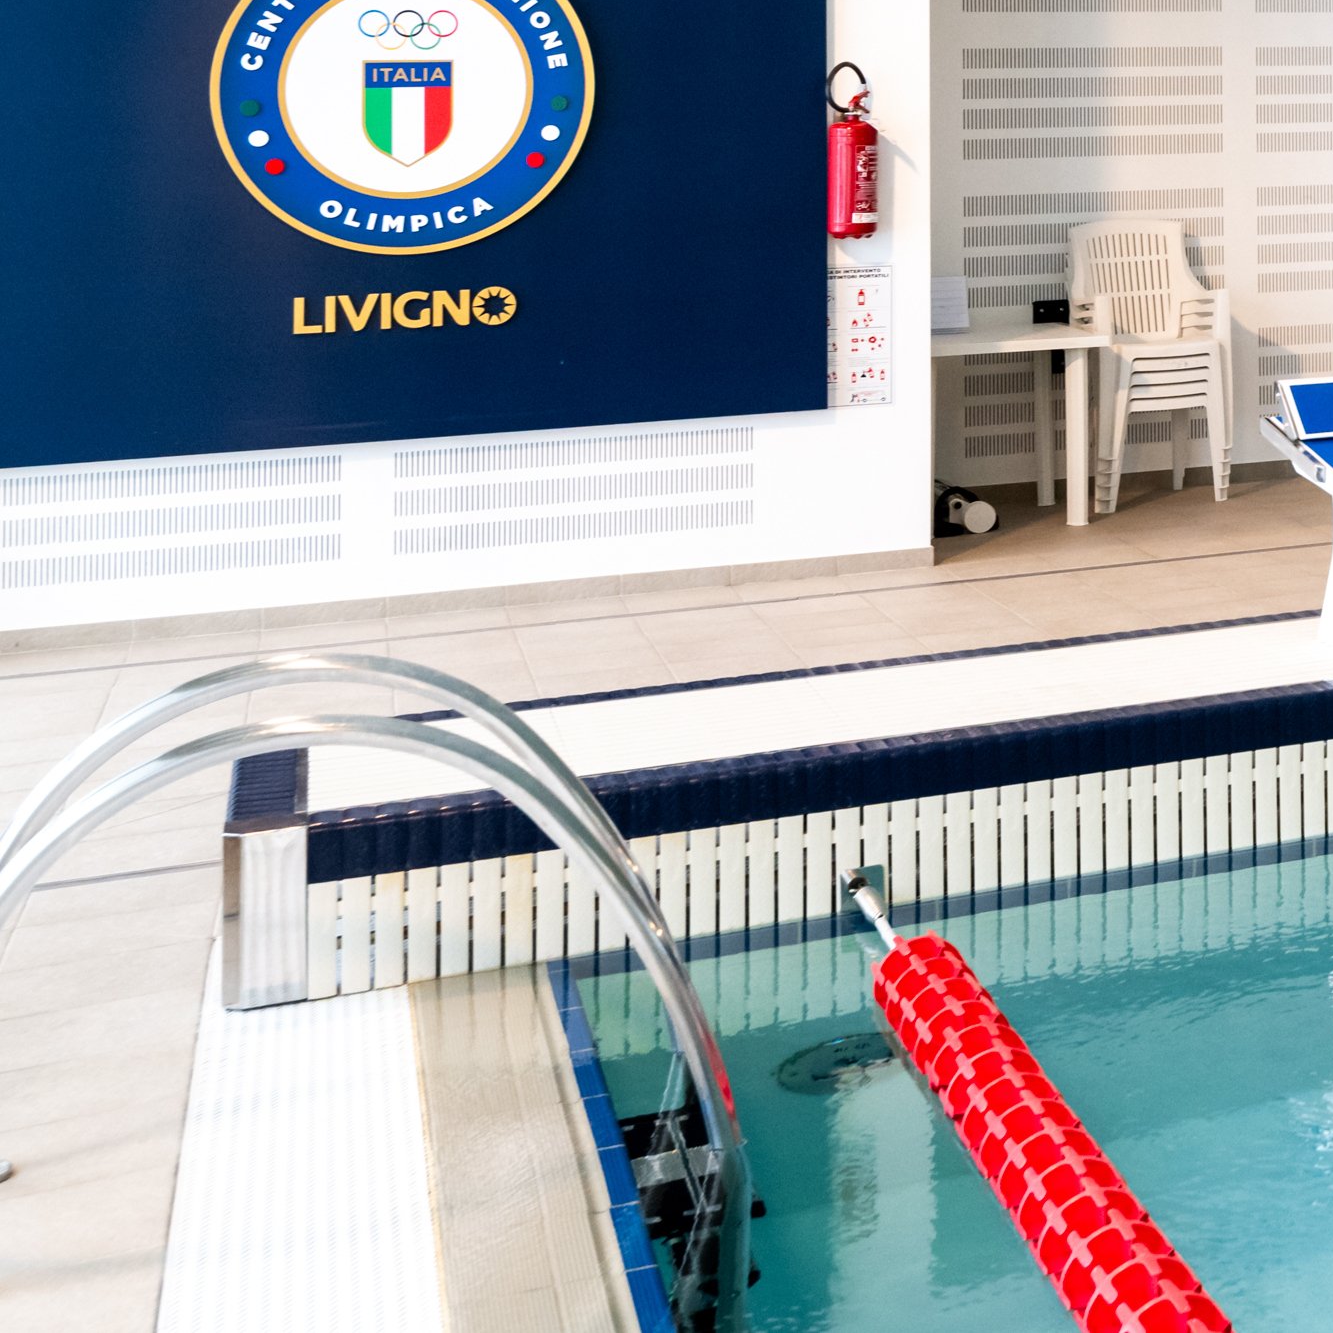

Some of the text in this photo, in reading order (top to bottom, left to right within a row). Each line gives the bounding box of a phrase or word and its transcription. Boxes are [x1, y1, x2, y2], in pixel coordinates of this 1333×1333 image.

[371, 66, 447, 83] ITALIA
[319, 196, 494, 233] OLIMPICA
[292, 285, 518, 335] LIVIGNO
